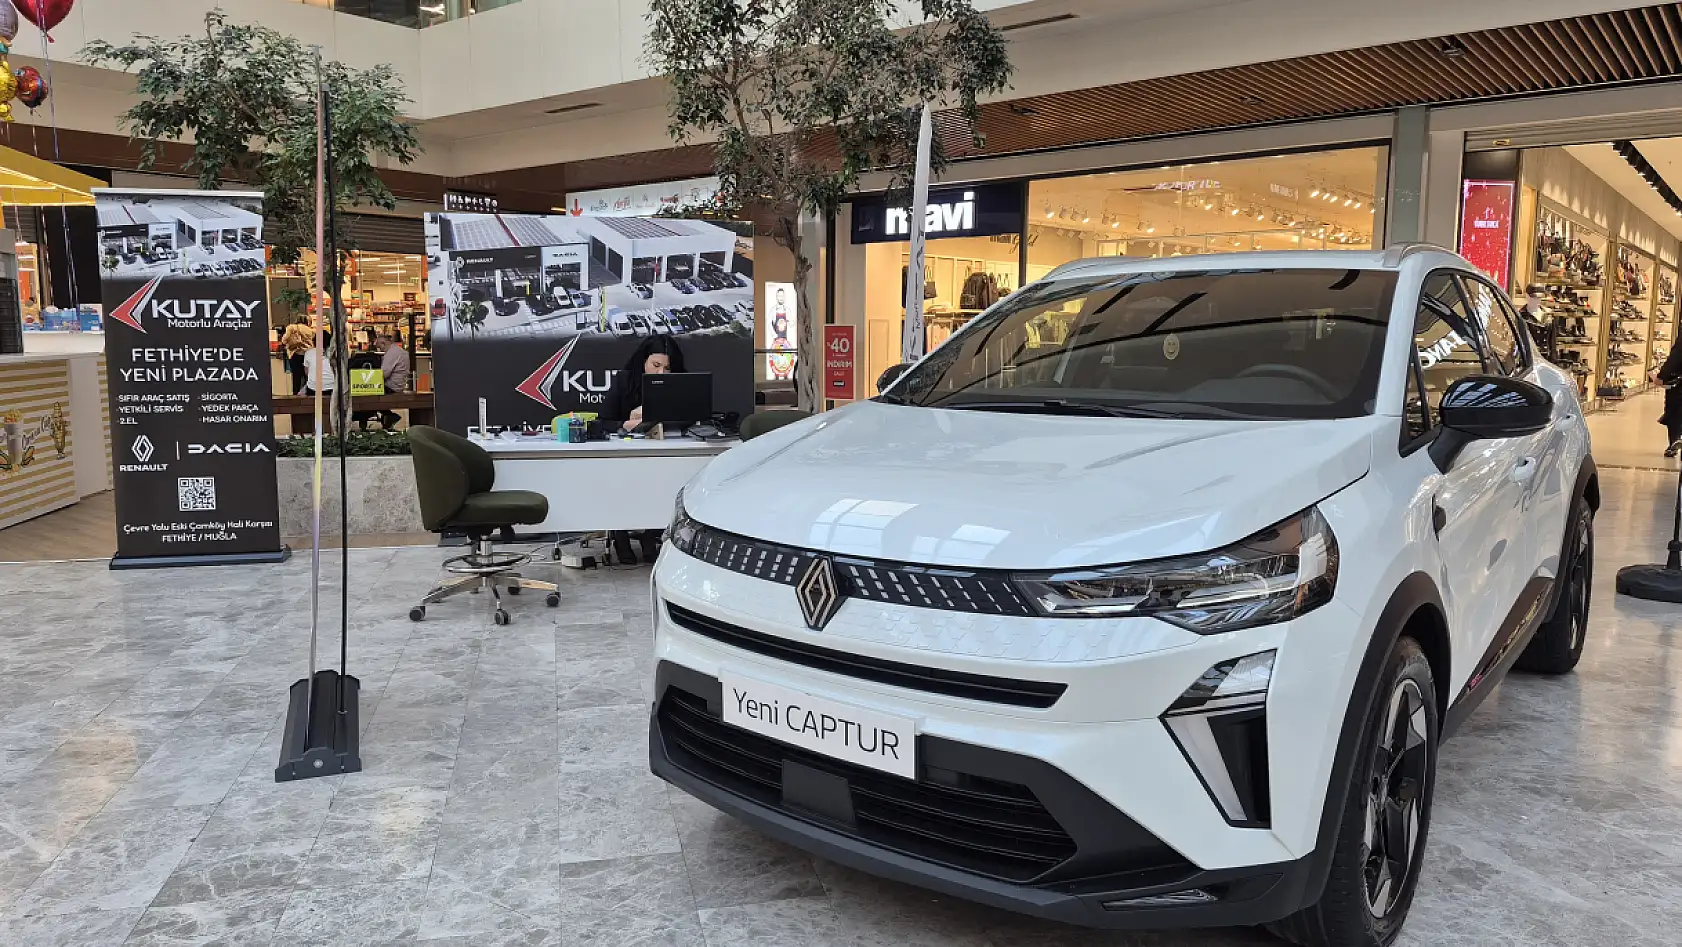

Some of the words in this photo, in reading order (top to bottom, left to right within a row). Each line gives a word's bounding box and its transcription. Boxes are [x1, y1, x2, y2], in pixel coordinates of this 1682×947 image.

[152, 299, 261, 318] KUTAY
[168, 318, 211, 328] Motorlu
[213, 318, 252, 331] Araçlar
[132, 345, 245, 362] FETHİYE'DE
[120, 366, 167, 382] YENİ
[173, 367, 259, 381] PLAZADA
[563, 370, 621, 392] KU
[118, 394, 140, 402] SIFIR
[142, 394, 164, 403] ARAÇ
[201, 392, 238, 401] SİGORTA
[580, 393, 606, 404] Mot
[118, 404, 151, 413] YETKİLİ
[153, 404, 184, 412] SERVİS
[201, 404, 230, 412] YEDEK
[232, 404, 259, 413] PARÇA
[119, 417, 139, 425] 2.EL
[202, 415, 231, 423] HASAR
[188, 443, 270, 454] DACIA
[119, 464, 169, 472] RENAULT
[123, 524, 149, 534] Çevre
[151, 523, 170, 531] Yolu
[171, 522, 187, 530] Eski
[189, 520, 226, 532] Çamköy
[228, 521, 243, 529] Hali
[162, 531, 197, 542] FETHİYE
[204, 531, 237, 540] MUĞLA
[733, 687, 778, 725] Yeni
[786, 705, 899, 759] CAPTUR
